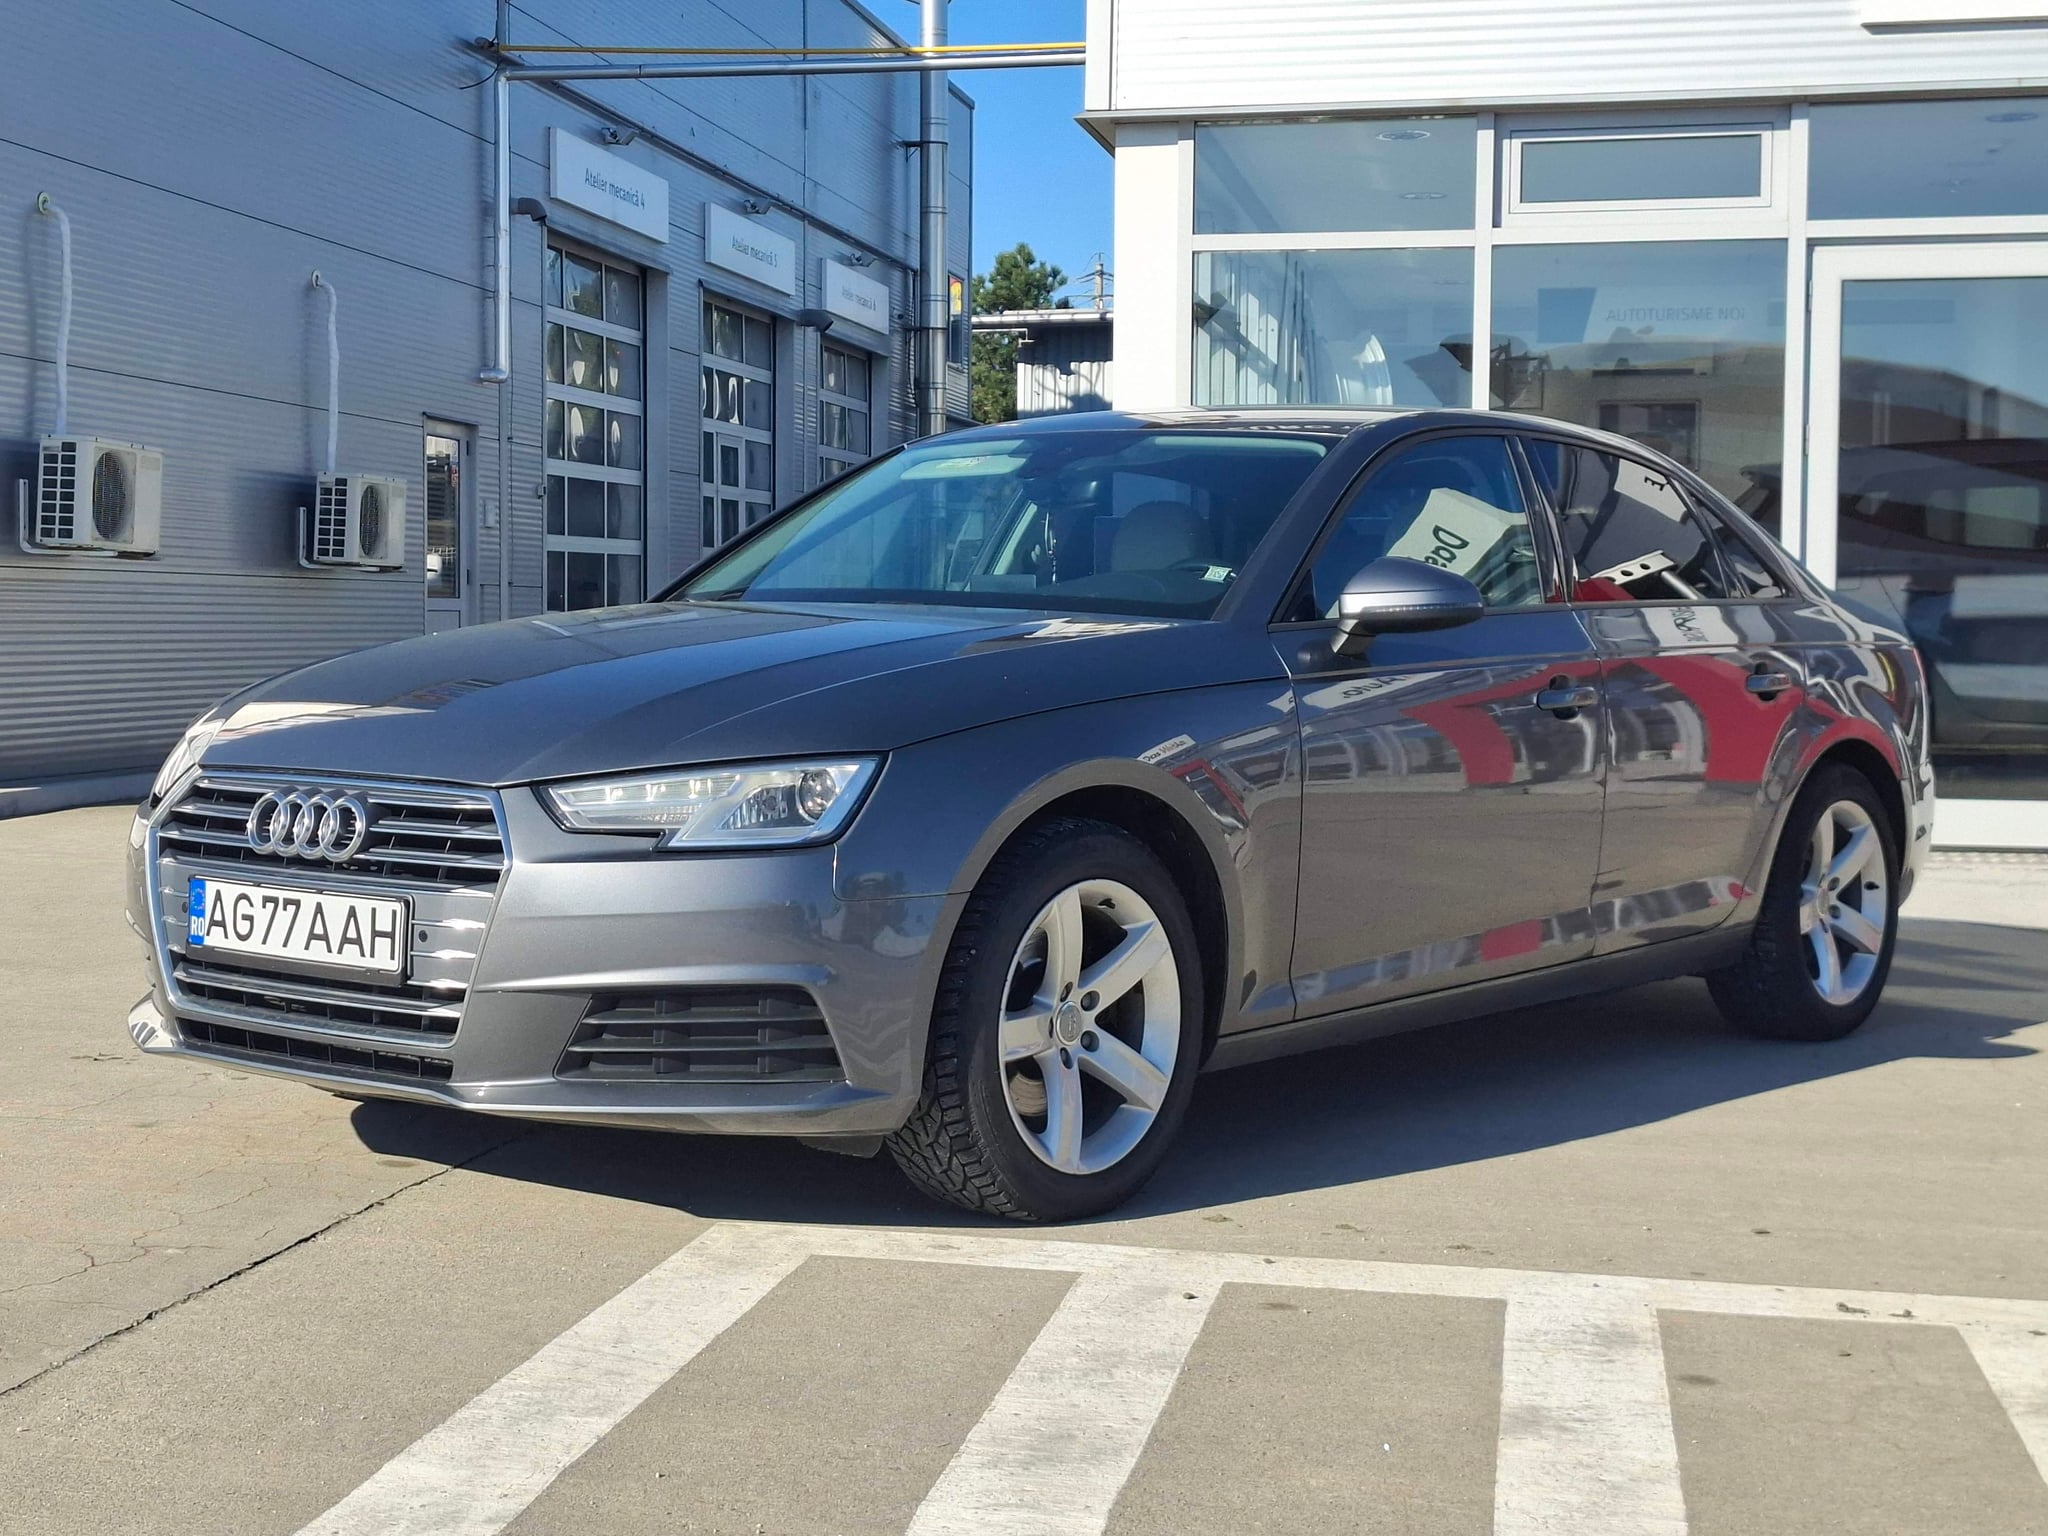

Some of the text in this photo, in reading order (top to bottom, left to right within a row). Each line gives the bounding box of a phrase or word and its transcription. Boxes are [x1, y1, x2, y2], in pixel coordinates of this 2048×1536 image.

[585, 167, 646, 210] Atelier mecanică 4
[1606, 307, 1713, 322] AUTOTURISME
[191, 915, 205, 937] RO
